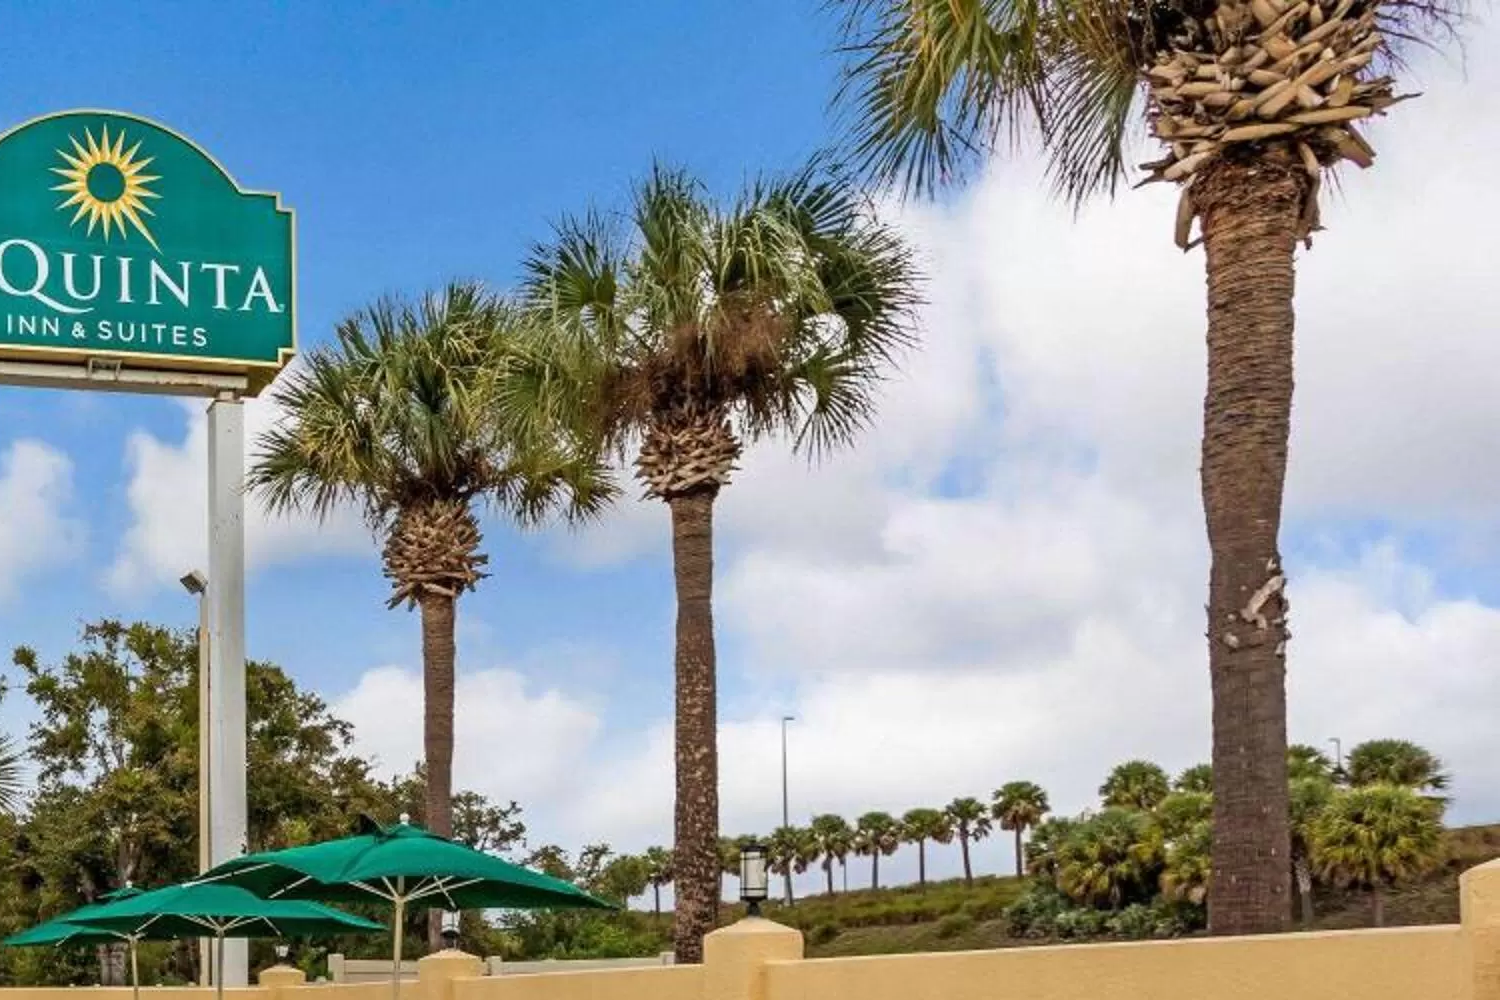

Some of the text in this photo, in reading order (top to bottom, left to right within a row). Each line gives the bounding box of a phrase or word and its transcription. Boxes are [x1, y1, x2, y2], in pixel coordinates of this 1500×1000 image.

[7, 313, 208, 347] INN & SUITES
